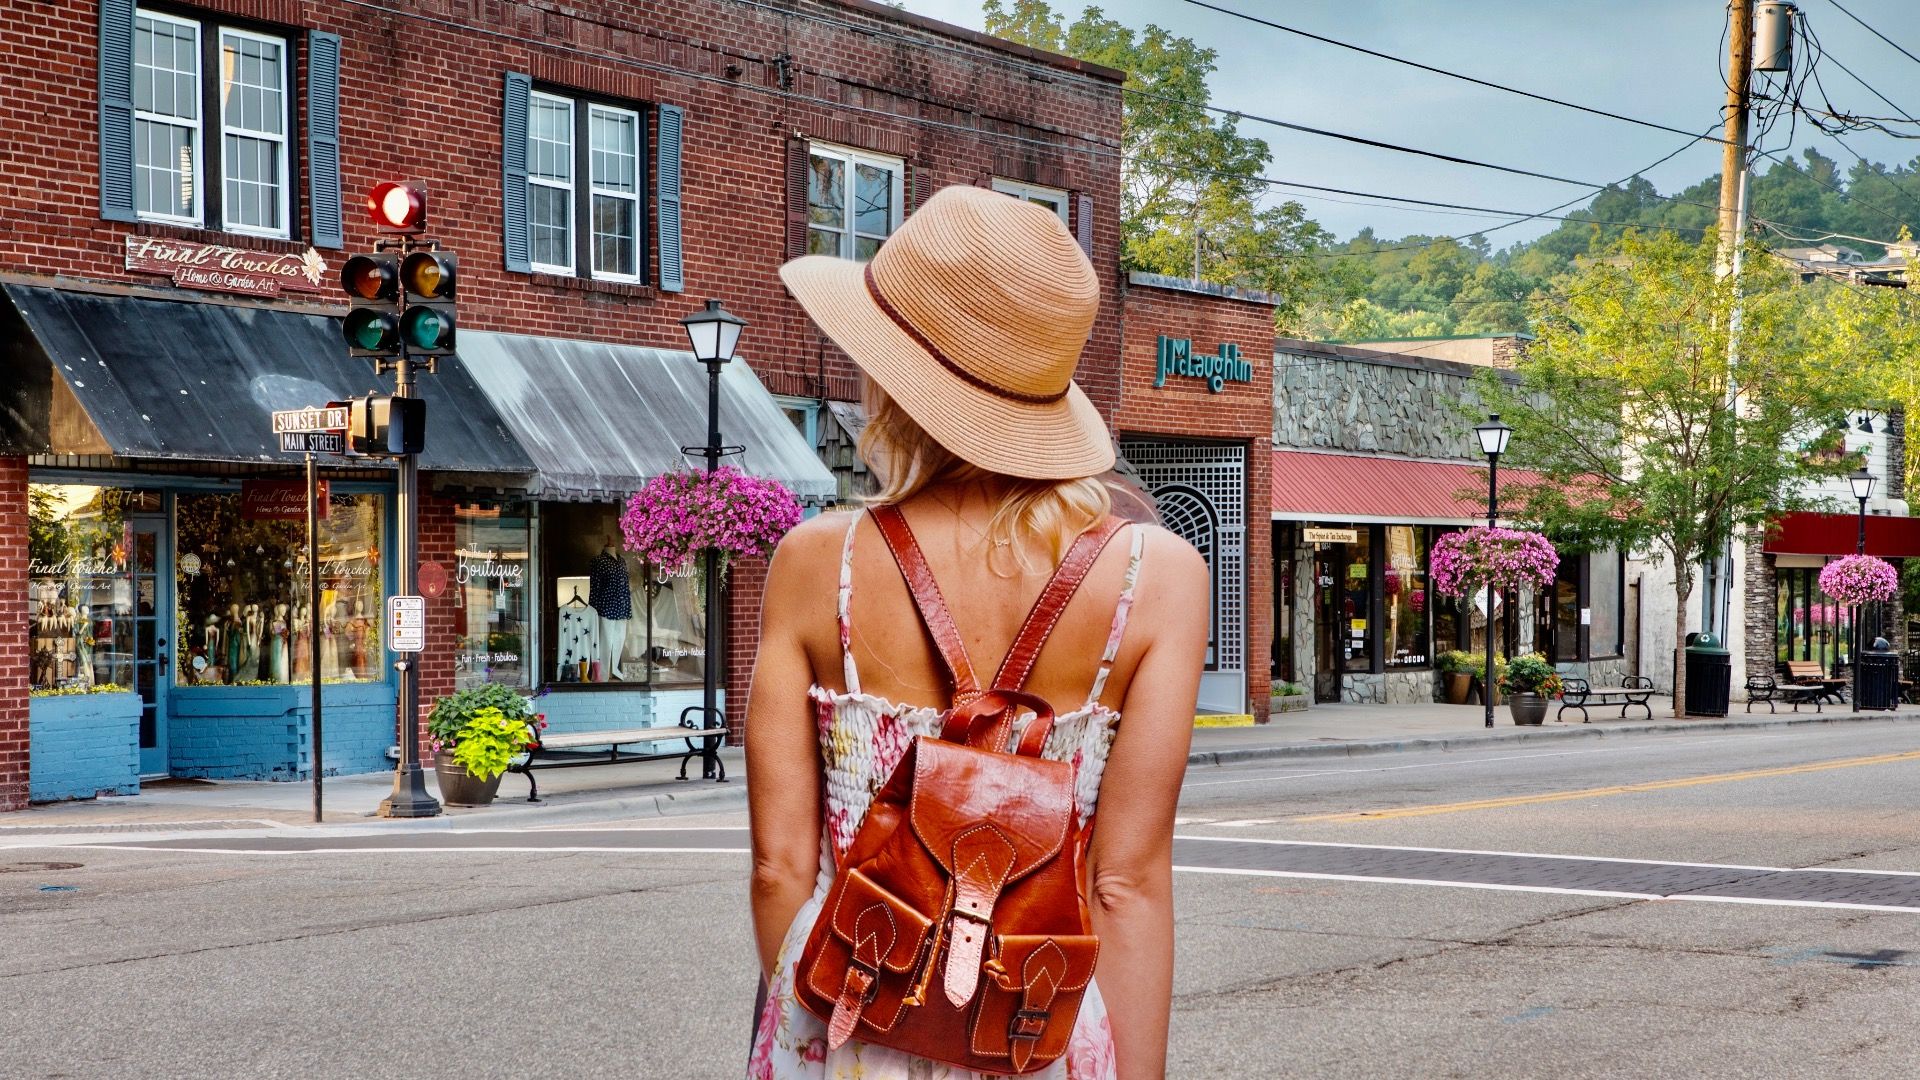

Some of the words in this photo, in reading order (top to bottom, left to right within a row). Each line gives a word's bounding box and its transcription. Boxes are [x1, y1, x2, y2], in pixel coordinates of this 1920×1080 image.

[137, 239, 214, 265] Final
[214, 248, 299, 277] Touches
[181, 268, 209, 284] Home
[209, 271, 223, 286] &
[223, 273, 255, 290] Garden
[255, 277, 274, 291] Art
[277, 412, 321, 431] SUNSET
[327, 410, 345, 427] DR.
[284, 433, 305, 450] MAIN
[309, 435, 339, 451] STREET
[468, 543, 482, 557] The
[28, 551, 73, 574] Final
[69, 553, 117, 576] Touches
[332, 556, 371, 576] Touches
[456, 548, 523, 596] Boutique
[461, 654, 472, 663] Fun
[475, 652, 491, 663] Fresh
[494, 651, 518, 662] Fabulous
[662, 648, 672, 657] Fun
